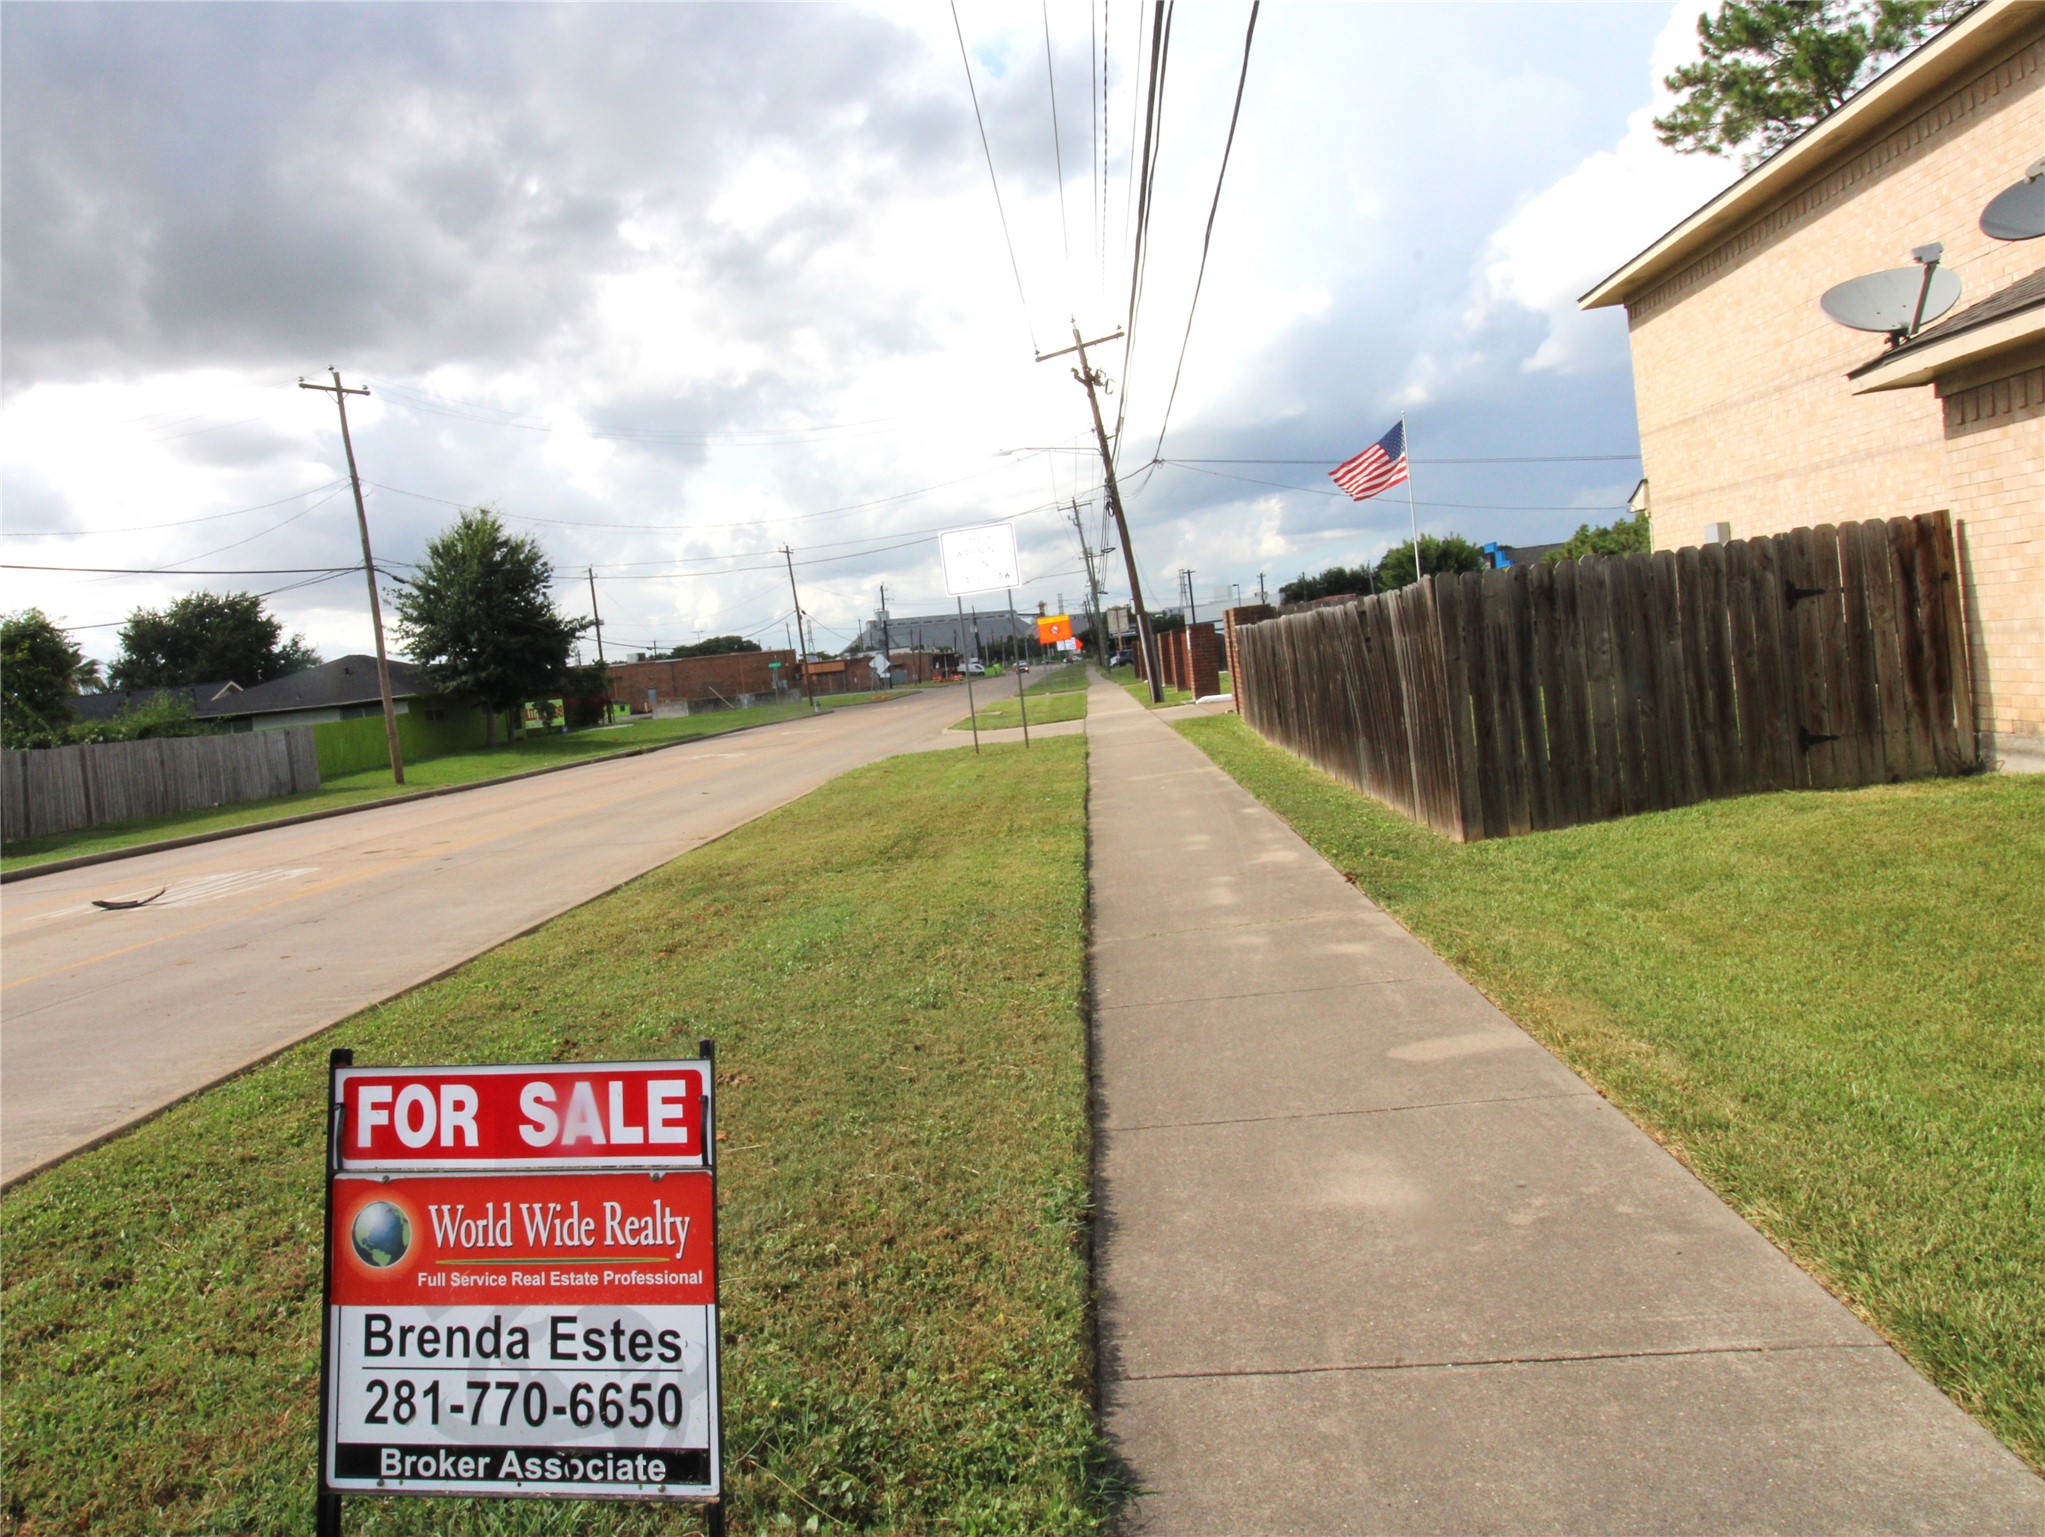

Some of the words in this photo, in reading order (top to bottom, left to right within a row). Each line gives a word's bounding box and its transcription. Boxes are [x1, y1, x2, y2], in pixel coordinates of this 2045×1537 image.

[357, 1084, 479, 1148] FOR
[519, 1080, 688, 1147] SALE
[429, 1202, 512, 1248] World
[520, 1202, 595, 1247] Wide
[603, 1200, 690, 1260] Realty
[418, 1272, 446, 1286] Full
[450, 1272, 507, 1286] Service
[511, 1272, 546, 1285] Real
[550, 1271, 598, 1285] Estate
[603, 1270, 703, 1285] Professional
[364, 1314, 530, 1360] Brenda
[550, 1316, 682, 1362] Estes
[365, 1380, 683, 1428] 281-770-6650
[381, 1450, 489, 1478] Broker
[499, 1451, 666, 1481] Associate
